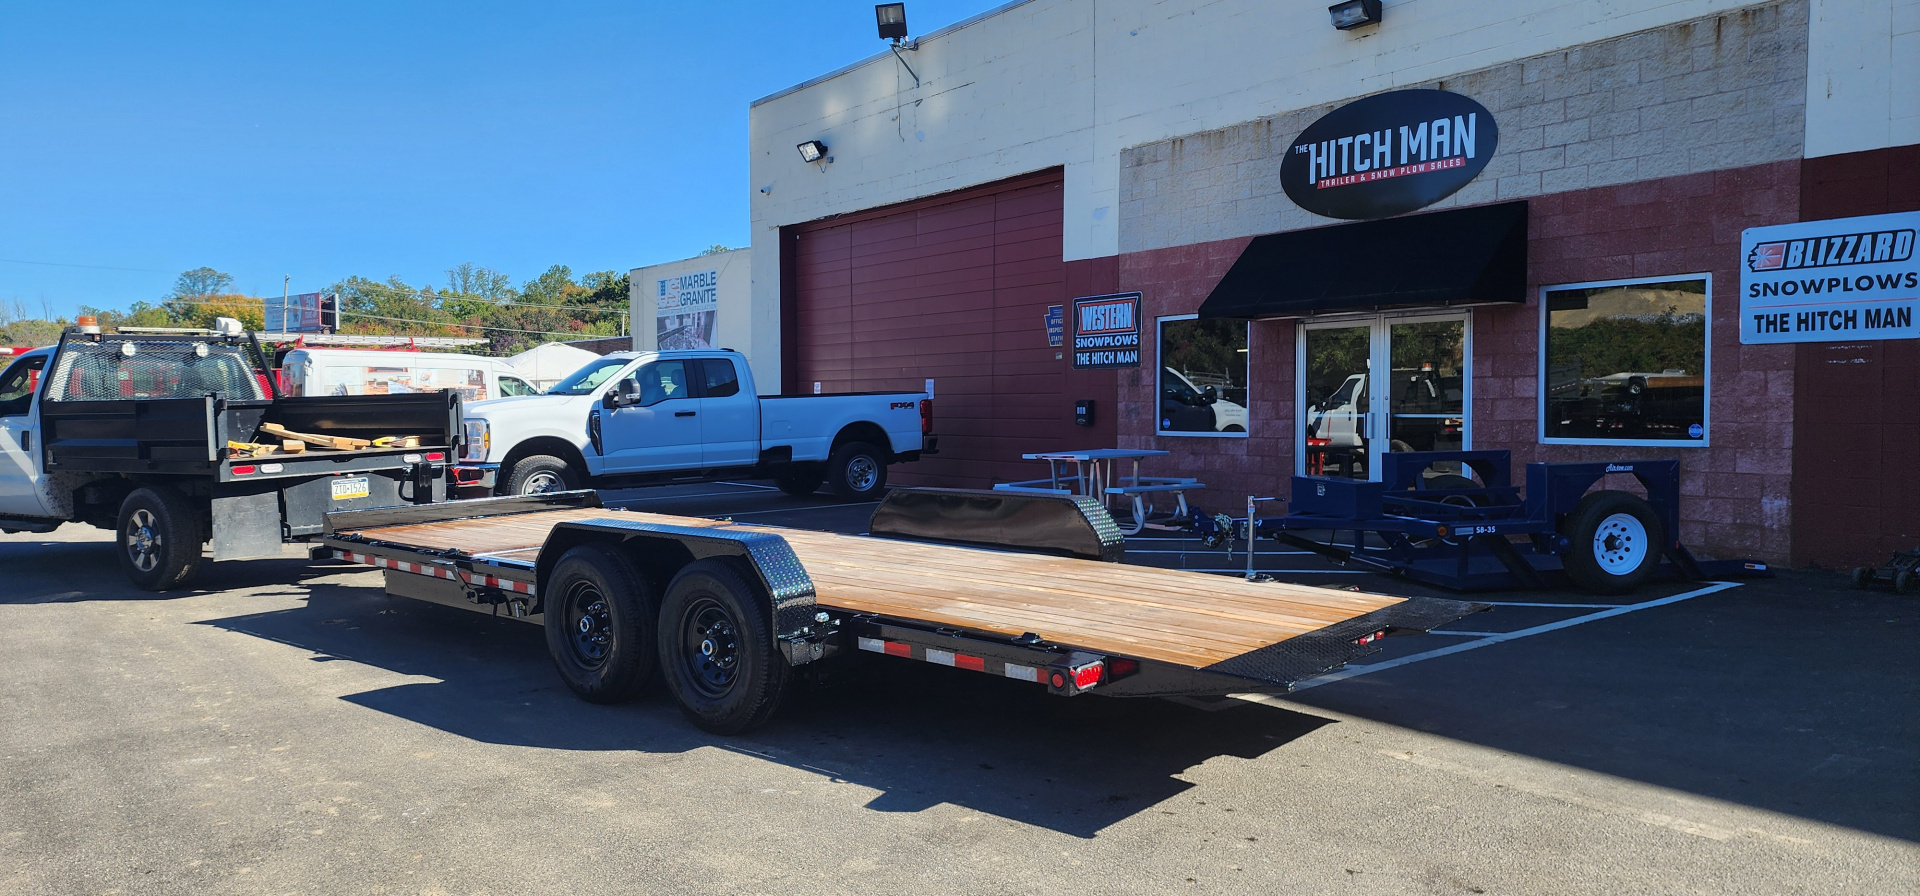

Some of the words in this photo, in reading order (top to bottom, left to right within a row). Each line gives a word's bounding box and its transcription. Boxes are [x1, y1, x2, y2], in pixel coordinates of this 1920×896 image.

[1295, 143, 1308, 154] THE
[1308, 128, 1392, 184] HITCH
[1400, 112, 1476, 165] MAN
[1320, 175, 1356, 188] TRAILER
[1360, 173, 1366, 181] &
[1371, 168, 1396, 180] SNOW
[1400, 163, 1426, 175] PLOW
[1430, 158, 1461, 170] SALES
[1786, 230, 1914, 268] BLIZZARD
[680, 271, 716, 290] MARBLE
[1749, 272, 1918, 298] SNOWPLOWS
[680, 288, 717, 306] GRANITE
[1081, 302, 1132, 331] WESTERN
[1753, 313, 1790, 333] THE
[1796, 309, 1857, 332] HITCH
[1864, 307, 1911, 329] MAN
[1075, 335, 1138, 348] SNOWPLOWS
[1076, 352, 1090, 365] THE
[1091, 351, 1114, 364] HITCH
[1116, 350, 1138, 363] MAN
[890, 402, 914, 410] FX4
[1476, 526, 1496, 534] SB-35
